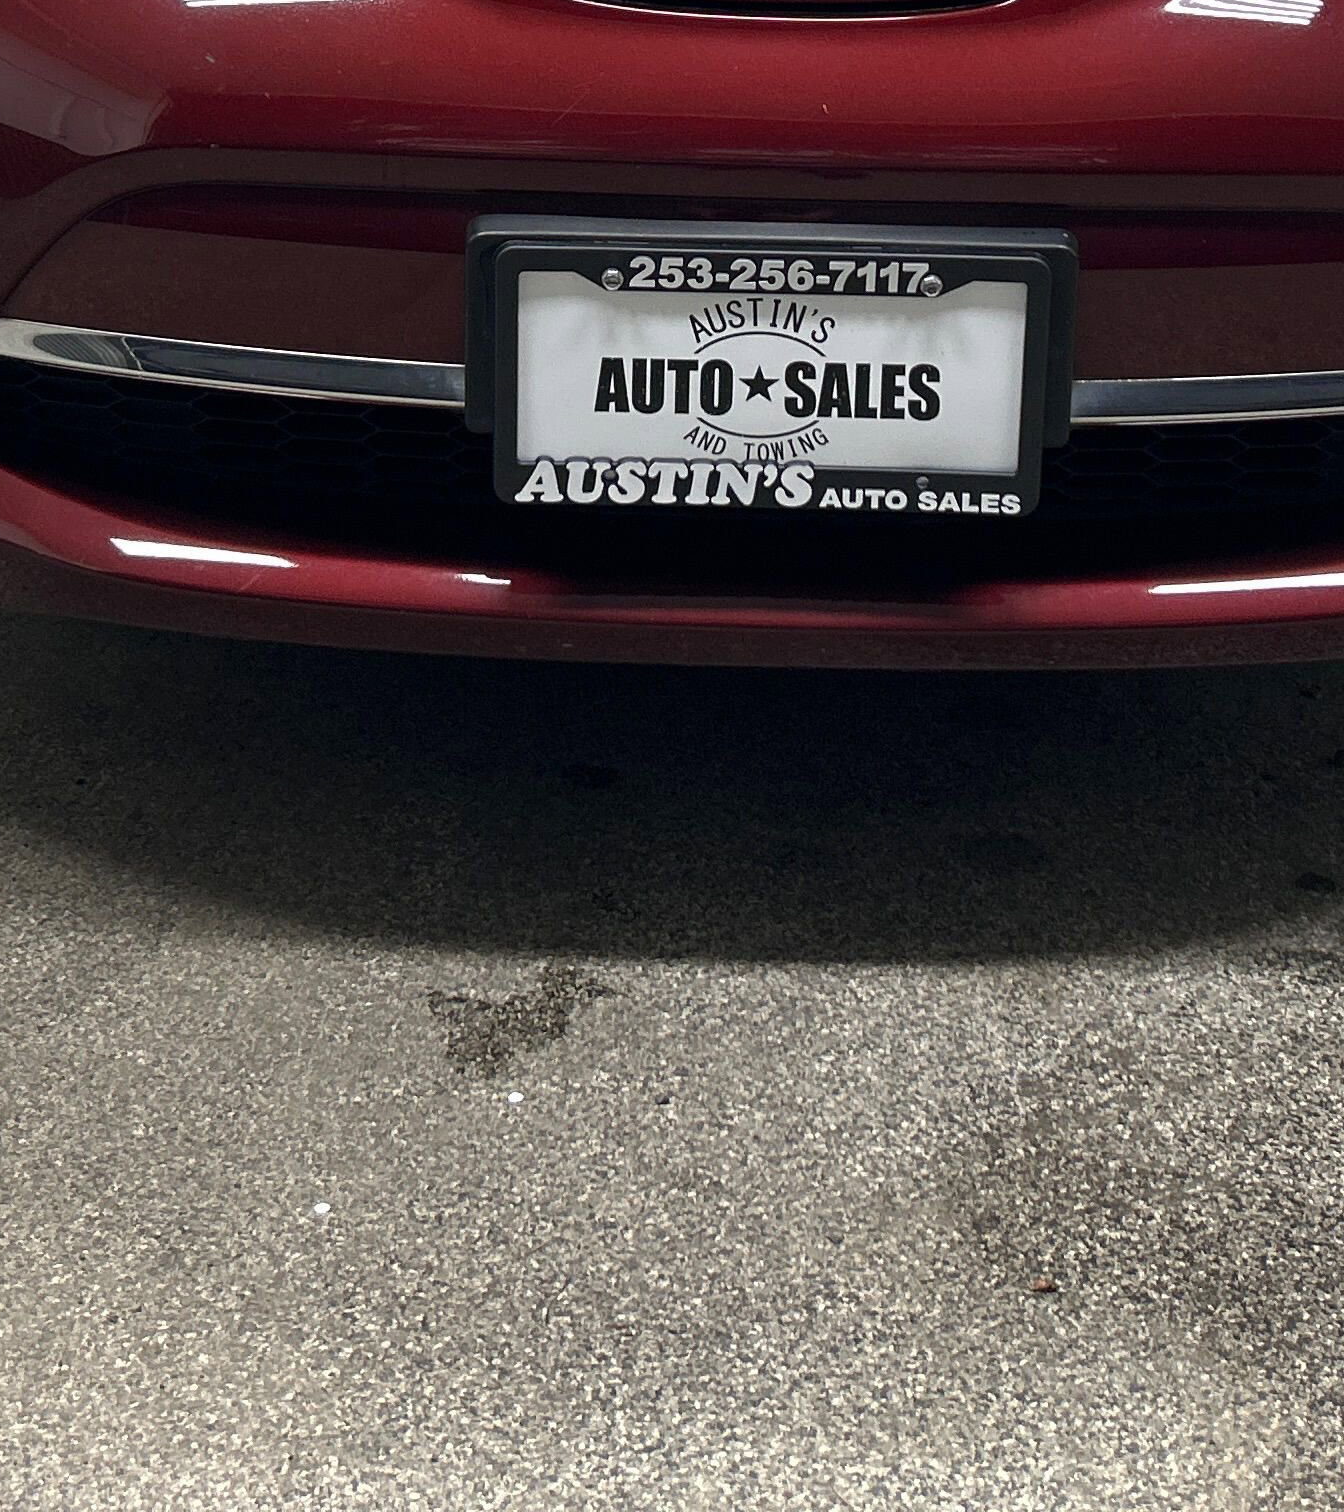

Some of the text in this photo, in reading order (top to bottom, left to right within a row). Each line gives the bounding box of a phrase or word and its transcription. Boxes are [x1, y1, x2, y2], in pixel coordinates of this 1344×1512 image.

[629, 256, 930, 295] 253-256-7117
[688, 297, 836, 345] AUSTIN'S
[594, 357, 941, 422] AUTO SALES
[682, 424, 829, 463] AND TOWING
[514, 459, 1022, 516] AUSTIN'S AUTO SALES
